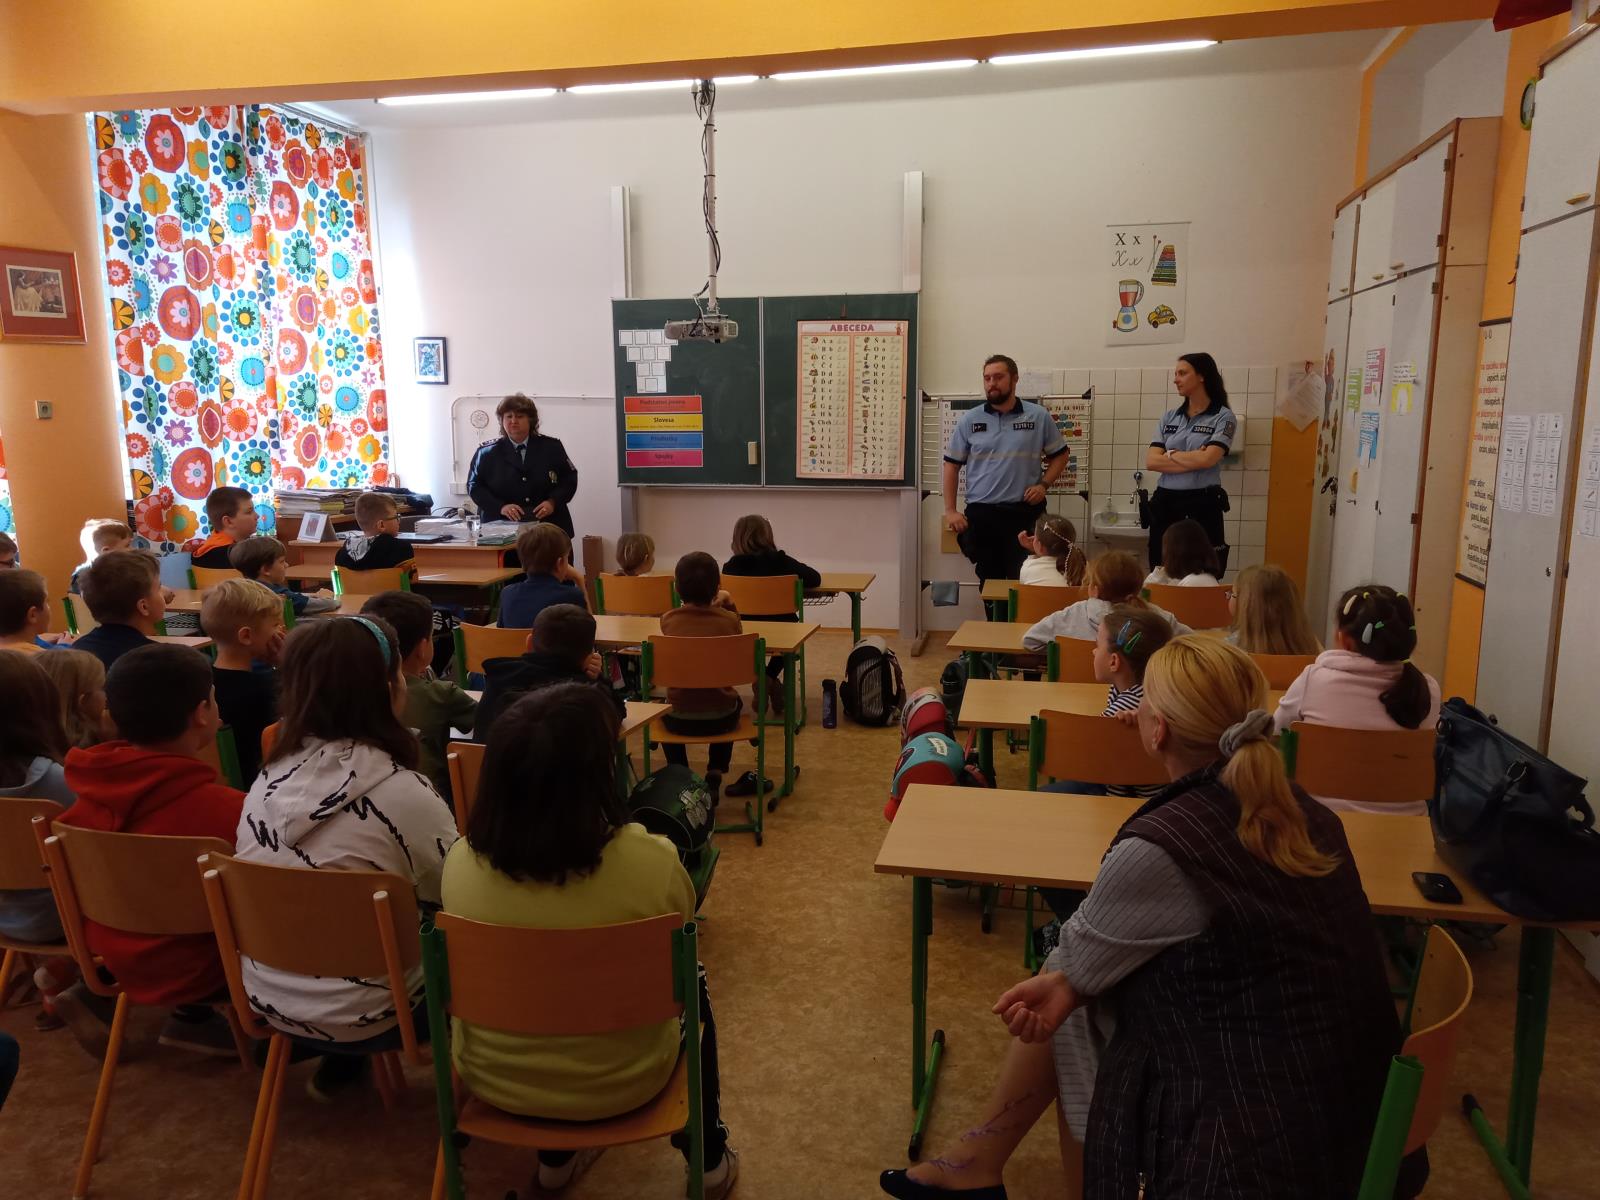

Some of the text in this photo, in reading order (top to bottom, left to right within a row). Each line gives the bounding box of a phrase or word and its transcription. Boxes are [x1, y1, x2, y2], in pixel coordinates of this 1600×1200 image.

[1115, 232, 1140, 246] X x
[1112, 250, 1128, 266] X
